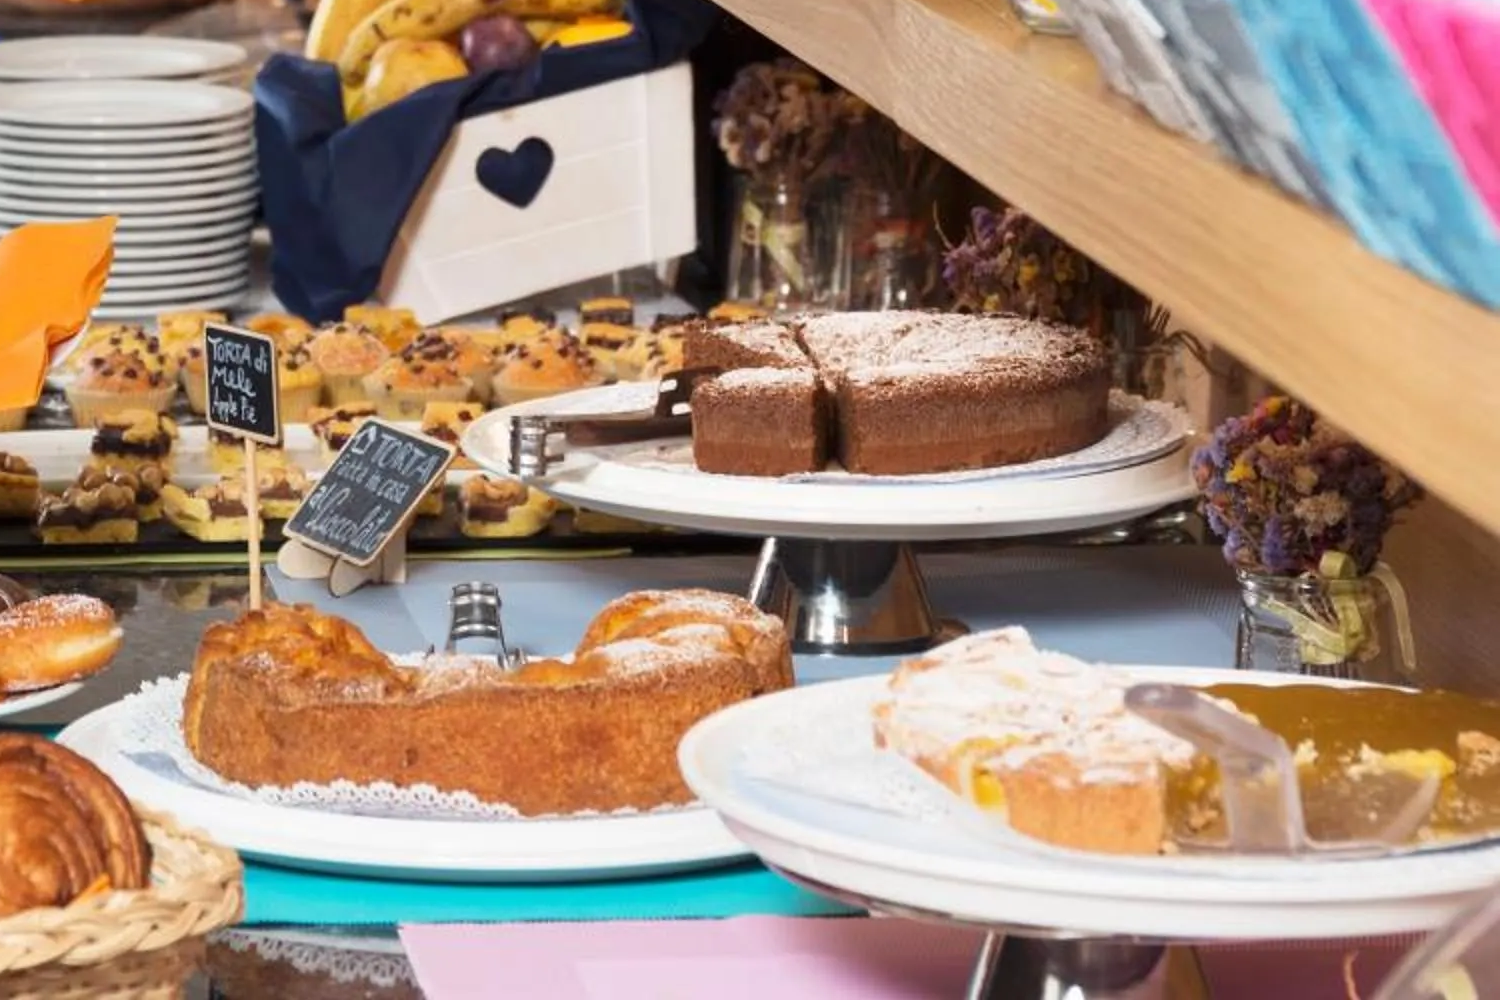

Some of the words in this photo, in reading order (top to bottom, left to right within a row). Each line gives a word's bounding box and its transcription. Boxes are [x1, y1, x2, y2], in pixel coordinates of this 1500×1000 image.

[207, 335, 252, 368] TORTA
[253, 345, 268, 374] di
[211, 364, 256, 397] Mele
[211, 386, 238, 423] Apple
[241, 395, 257, 424] Pie
[371, 432, 440, 485] TORTA
